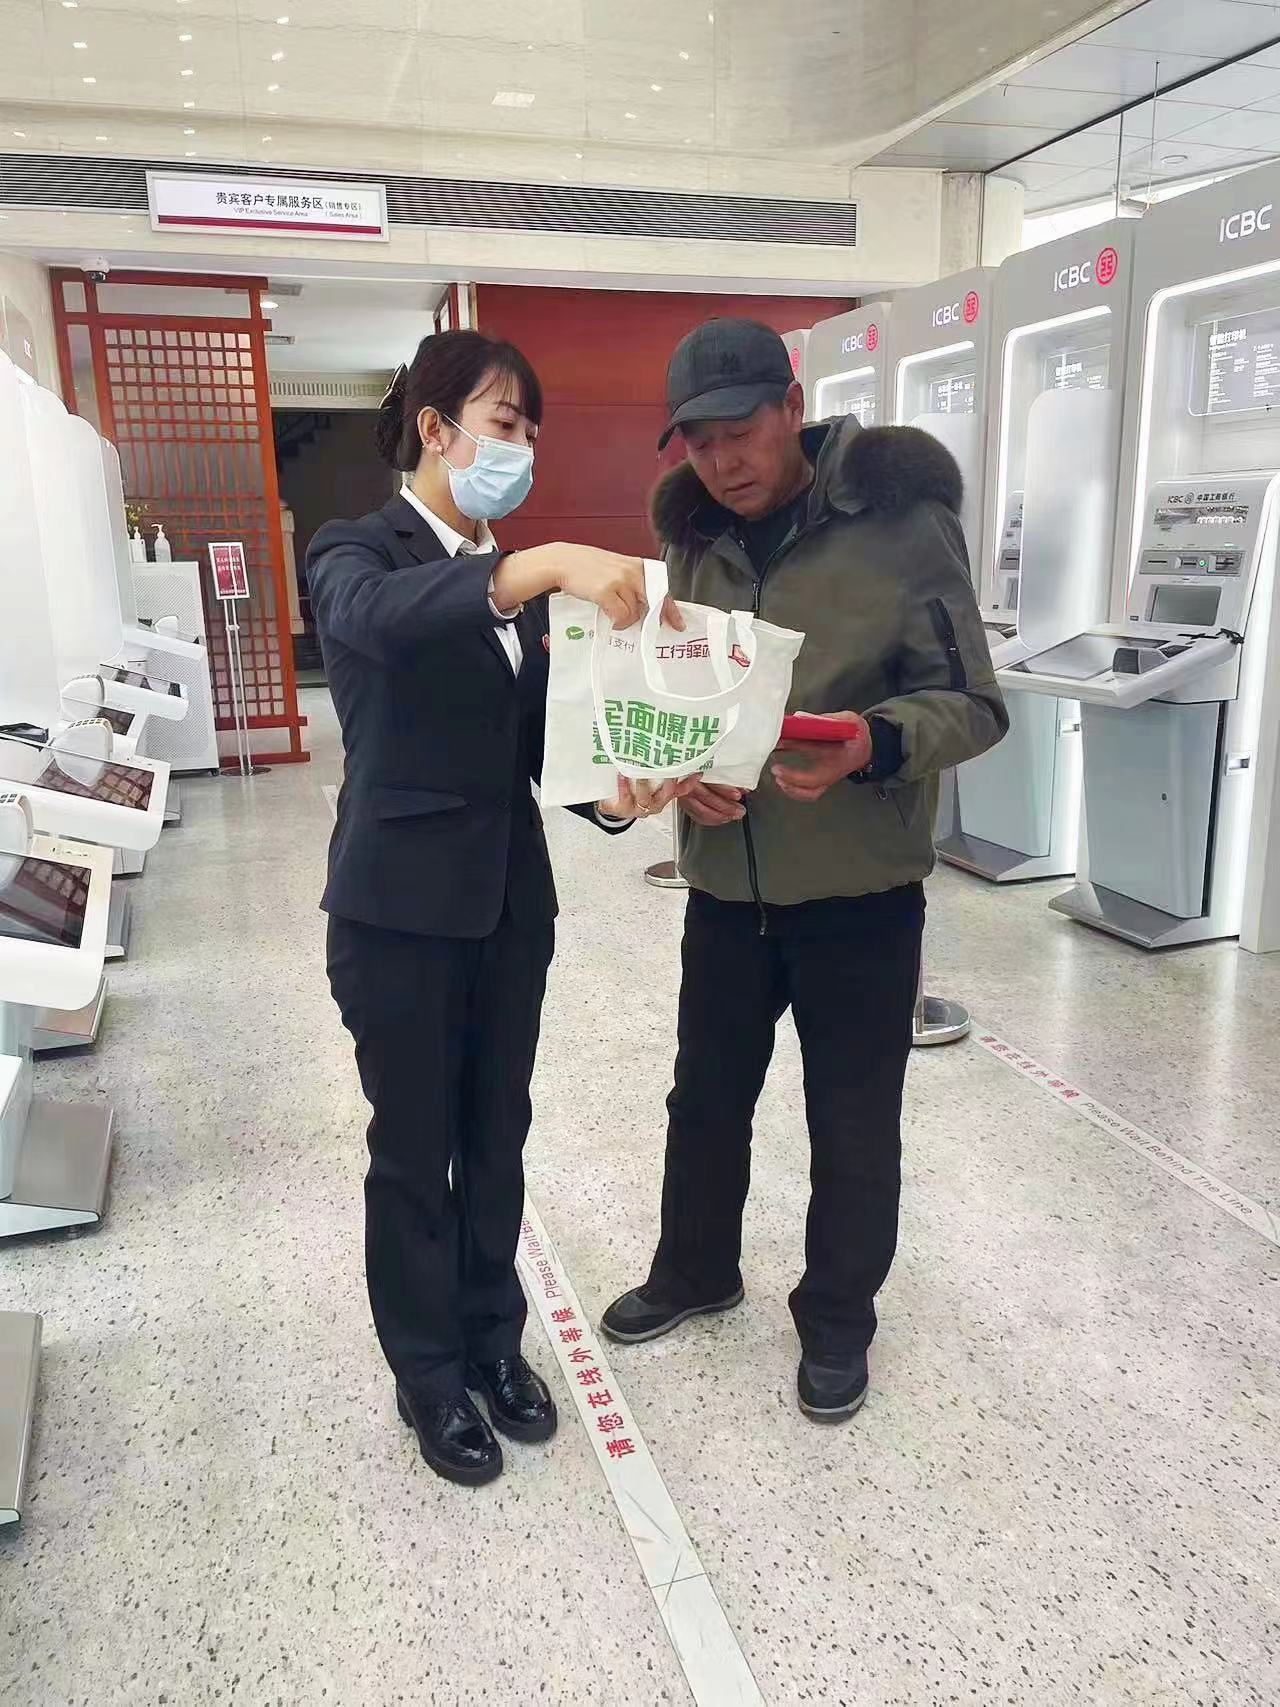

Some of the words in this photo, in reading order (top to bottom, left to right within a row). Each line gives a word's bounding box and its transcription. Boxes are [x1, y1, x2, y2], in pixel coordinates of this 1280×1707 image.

[216, 192, 324, 210] 贵宾客户专属服务区
[245, 208, 272, 216] Exclusive
[1219, 204, 1273, 243] ICBC
[1053, 261, 1091, 292] ICBC
[932, 302, 960, 327] ICBC
[841, 332, 864, 353] ICBC
[593, 699, 720, 747] 全面曝光
[1080, 1102, 1120, 1128] Please
[1120, 1127, 1151, 1147] Wait
[1146, 1144, 1194, 1176] Behind
[1197, 1174, 1220, 1193] The
[1219, 1192, 1253, 1215] Line
[523, 1234, 544, 1260] Wait
[536, 1260, 563, 1298] Please
[551, 1306, 637, 1460] 请您在线外等候
